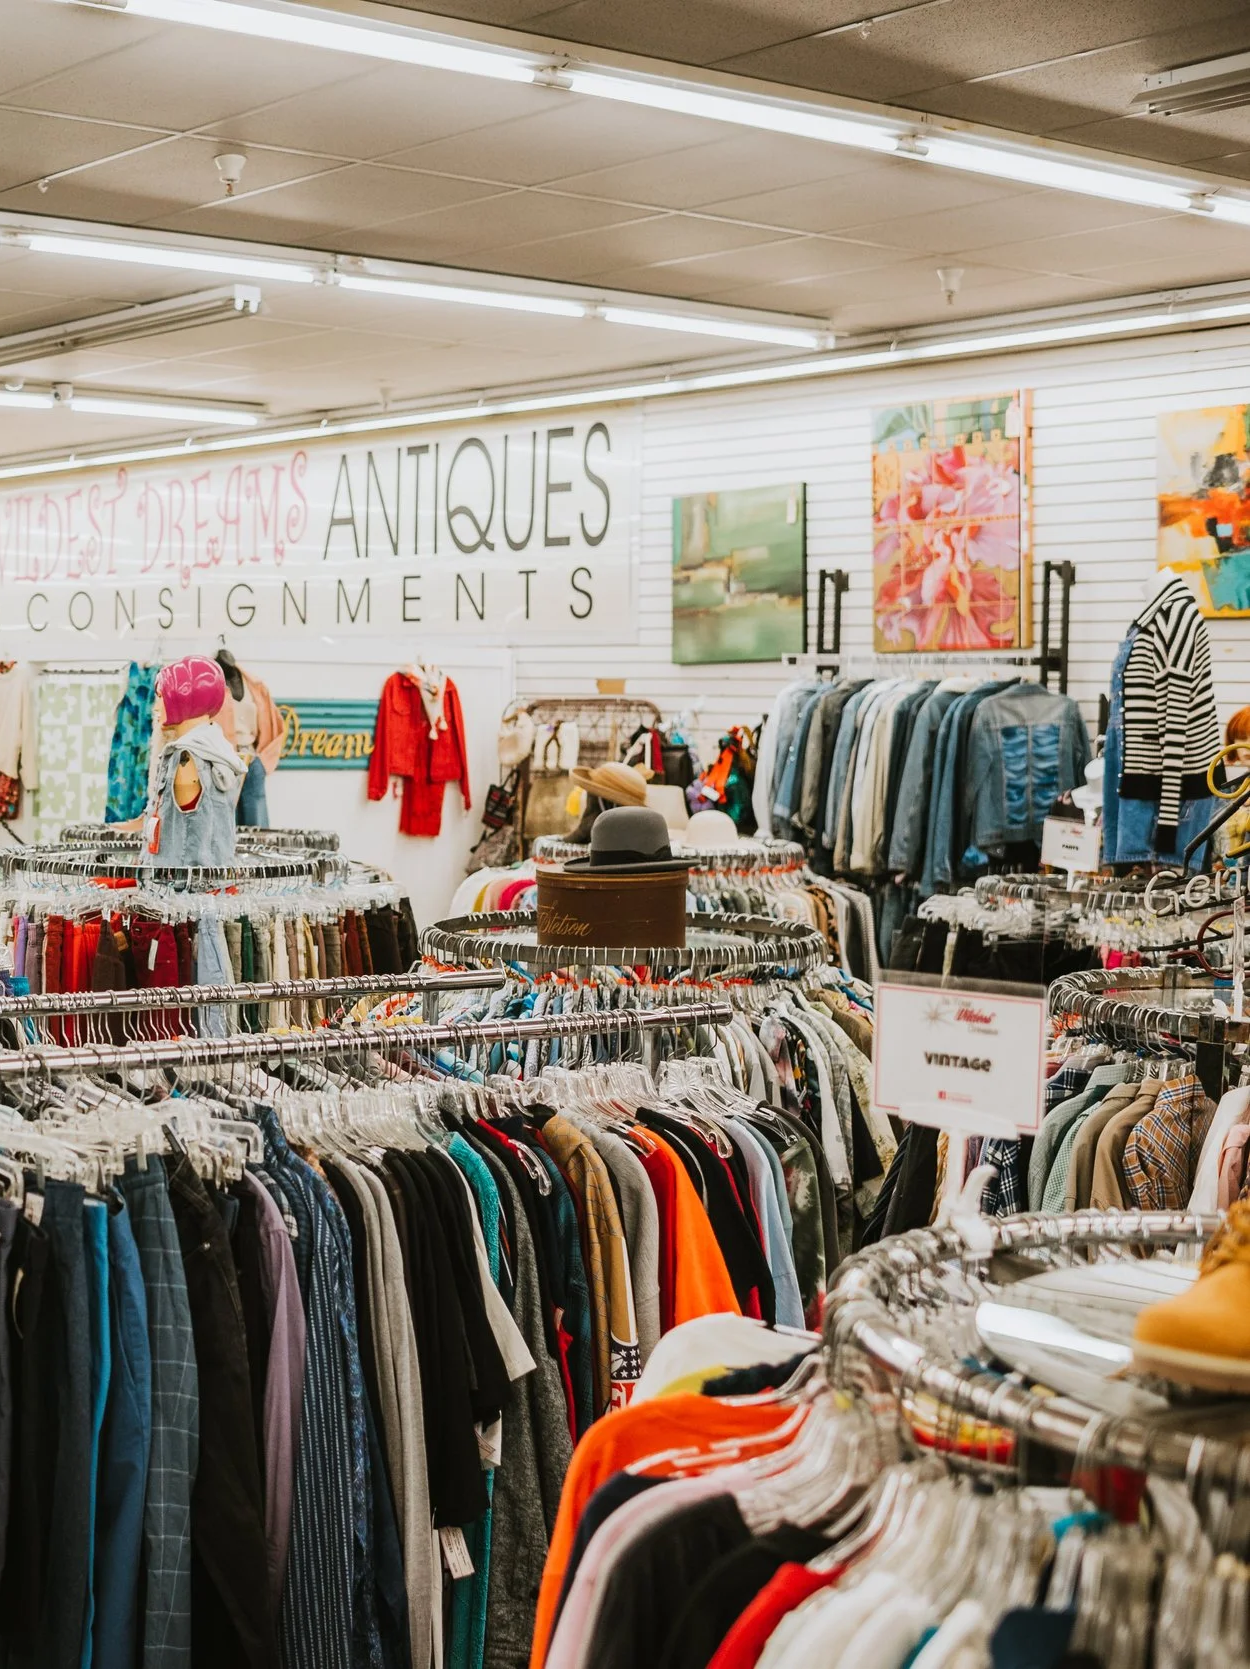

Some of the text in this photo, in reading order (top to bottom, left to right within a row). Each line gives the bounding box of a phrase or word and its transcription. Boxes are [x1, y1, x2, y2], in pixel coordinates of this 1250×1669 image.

[137, 450, 308, 590] DREAMS
[323, 422, 611, 560] ANTIQUES
[26, 566, 593, 632] CONSIGNMENTS
[1144, 865, 1250, 915] Gen
[924, 1051, 992, 1073] VINTAGE
